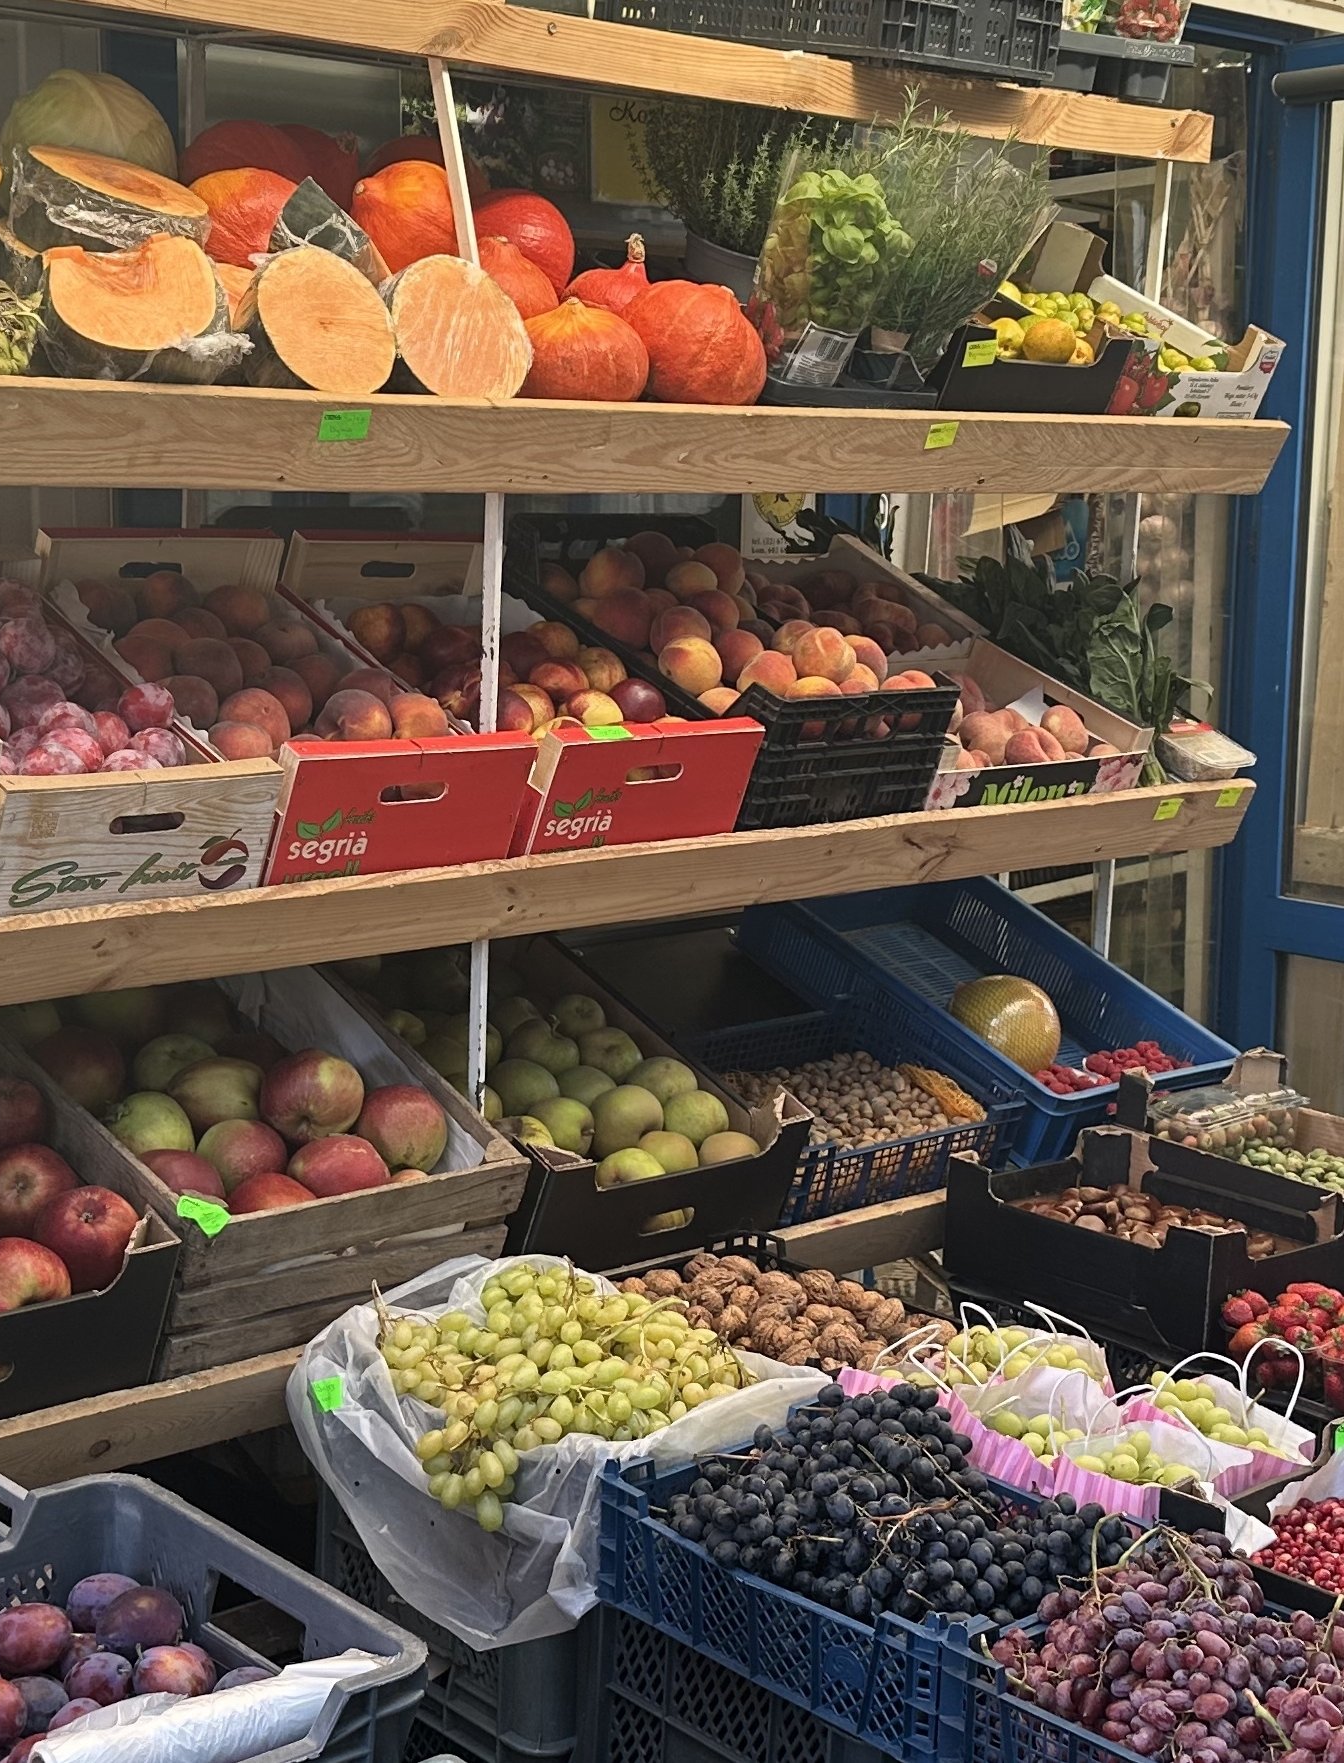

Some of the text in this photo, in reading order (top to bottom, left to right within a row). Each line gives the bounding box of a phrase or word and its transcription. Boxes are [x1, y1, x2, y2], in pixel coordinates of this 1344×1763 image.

[544, 809, 613, 840] segrià
[288, 830, 369, 864] segrià
[8, 852, 202, 908] Star fruit
